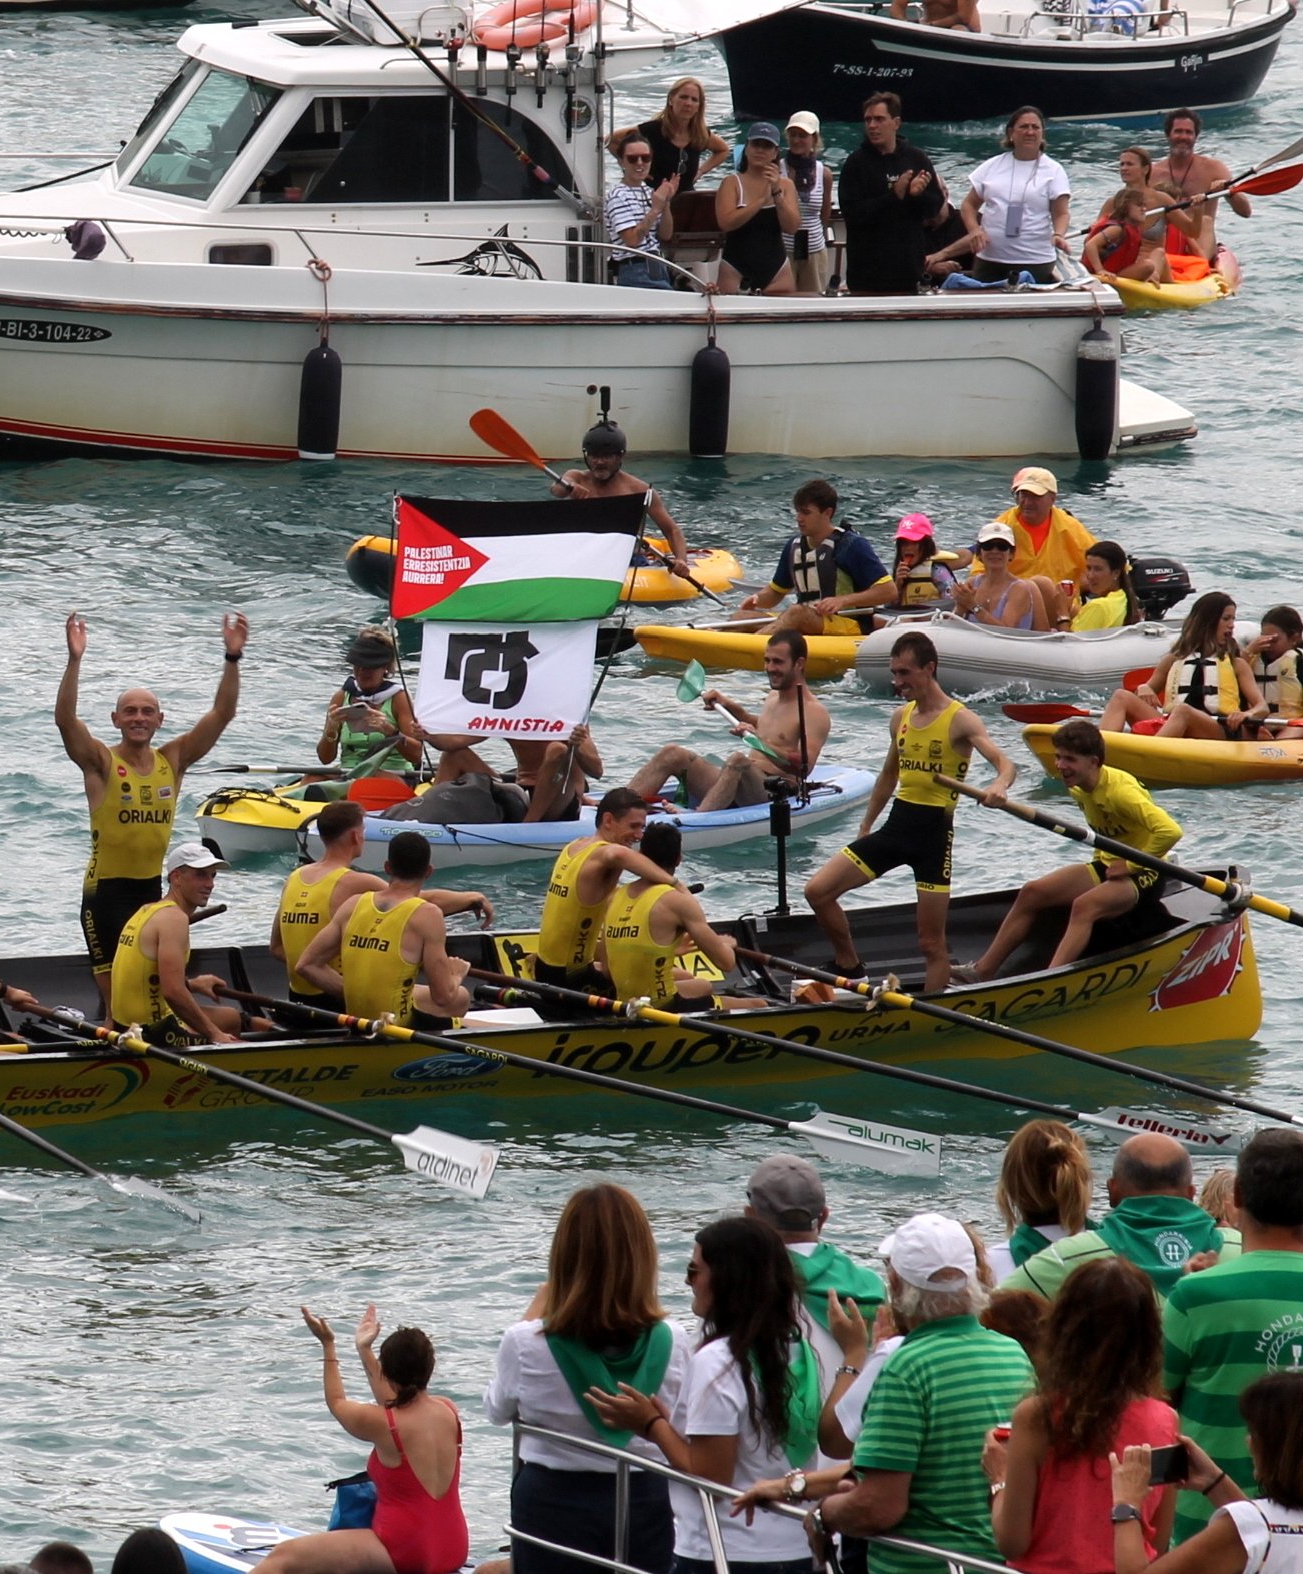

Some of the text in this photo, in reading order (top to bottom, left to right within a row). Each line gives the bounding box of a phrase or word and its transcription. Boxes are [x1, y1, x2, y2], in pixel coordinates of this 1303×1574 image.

[404, 545, 454, 559] PALESTINAR
[403, 557, 471, 572] ERRESISTENTZIA
[402, 571, 444, 584] AURRERA!
[467, 715, 564, 732] AMNISTIA
[899, 759, 943, 774] ORIALKI
[950, 762, 968, 801] OIO
[118, 809, 172, 825] ORIALKI
[548, 881, 569, 898] uma
[282, 911, 319, 924] auma
[85, 909, 103, 960] ORIALKI
[606, 924, 640, 938] auma
[349, 934, 390, 952] auma
[828, 1019, 911, 1042] URMA
[410, 1055, 487, 1079] Ford
[6, 1083, 109, 1101] Euskadi
[361, 1080, 498, 1098] EASO MOTOR
[847, 1124, 935, 1154] alumak
